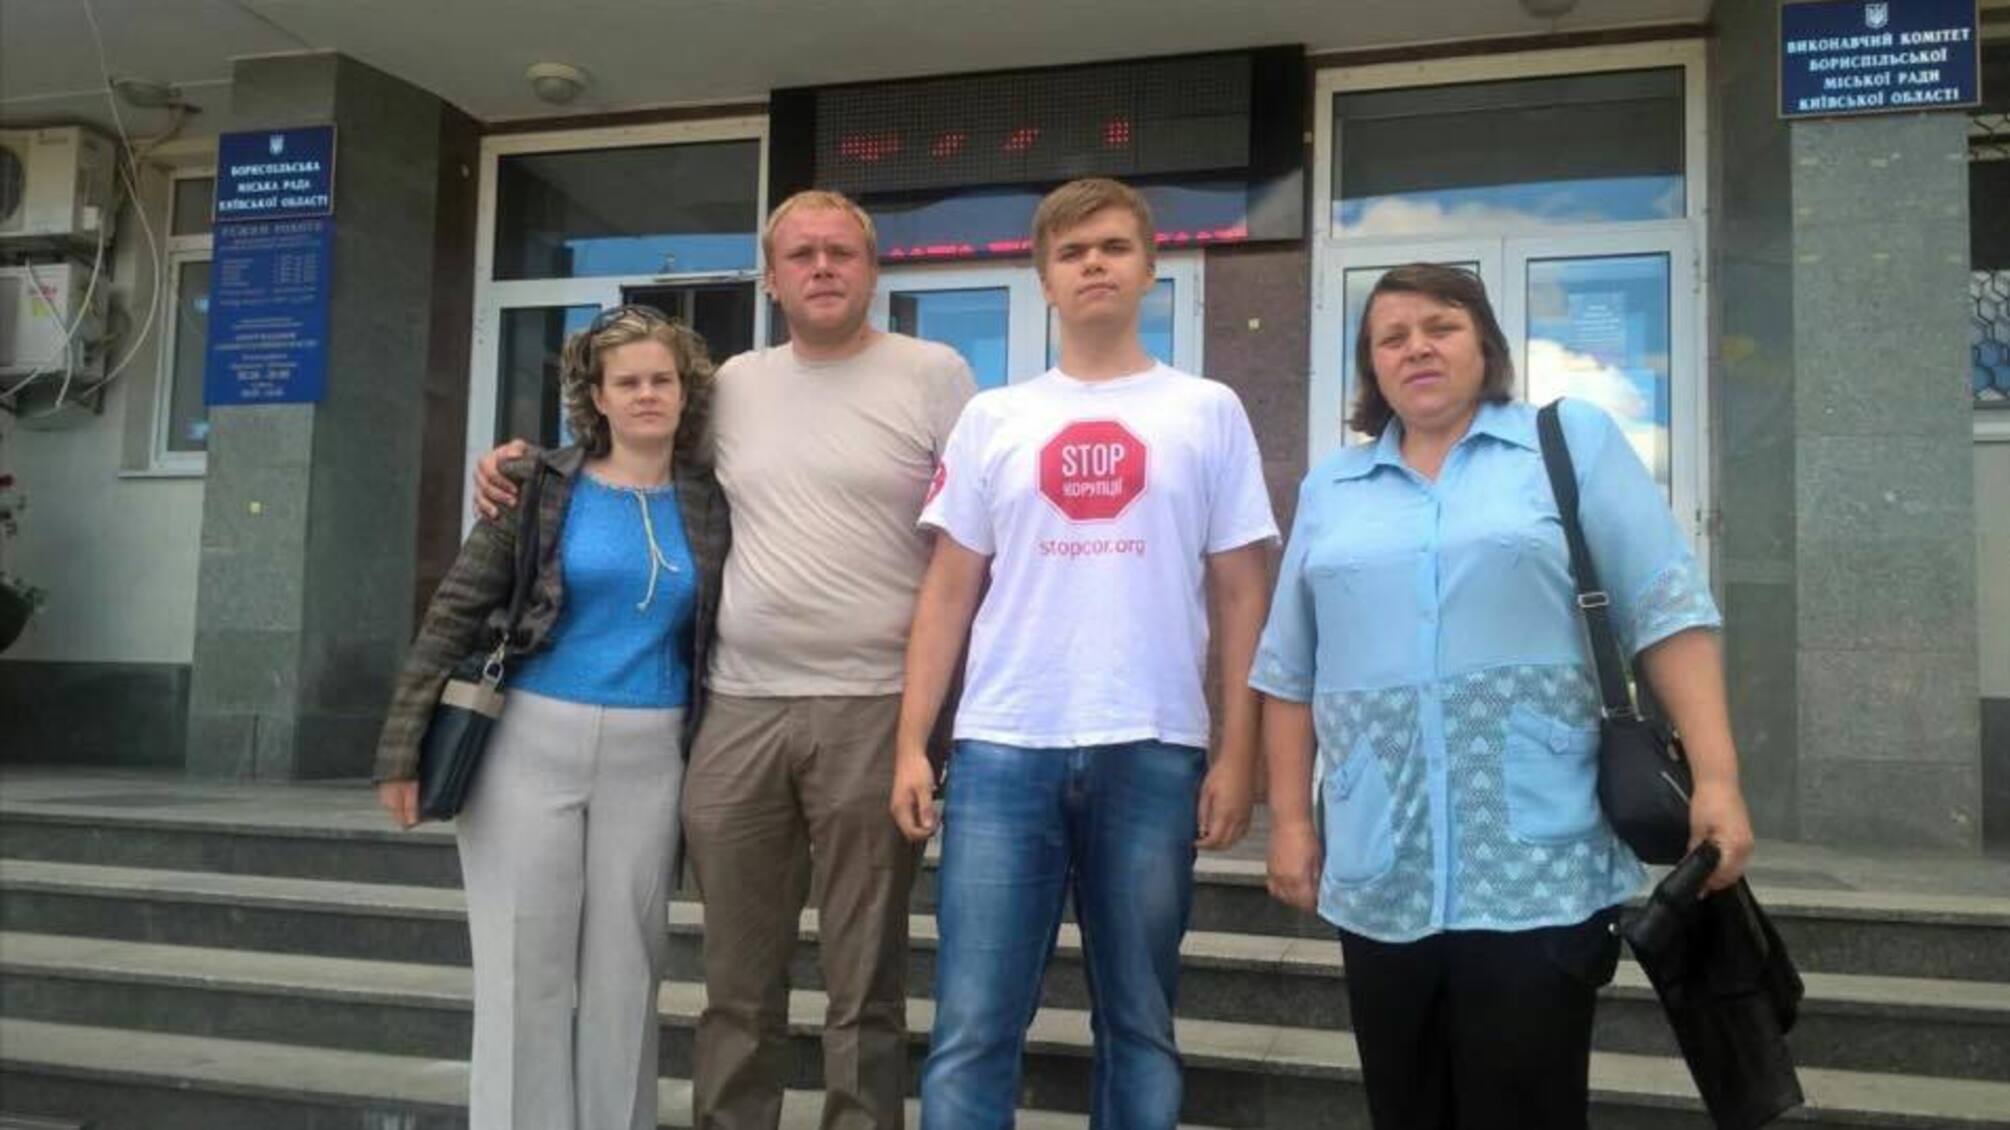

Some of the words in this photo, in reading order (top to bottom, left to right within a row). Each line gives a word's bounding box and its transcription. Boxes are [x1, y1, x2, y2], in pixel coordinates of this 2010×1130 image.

[1787, 33, 1893, 53] ВИКОНАВЧИЙ
[1900, 28, 1970, 45] КОМІТЕТ
[1809, 48, 1947, 71] БОРИСПІЛЬСЬКОЇ
[1823, 71, 1890, 89] МІСЬКОЇ
[1898, 69, 1940, 84] РАДИ
[1798, 92, 1884, 110] КИЇВСЬКОЇ
[1890, 88, 1959, 104] ОБЛАСТІ
[1062, 443, 1125, 477] STOP
[1039, 539, 1146, 559] stopcor.org
